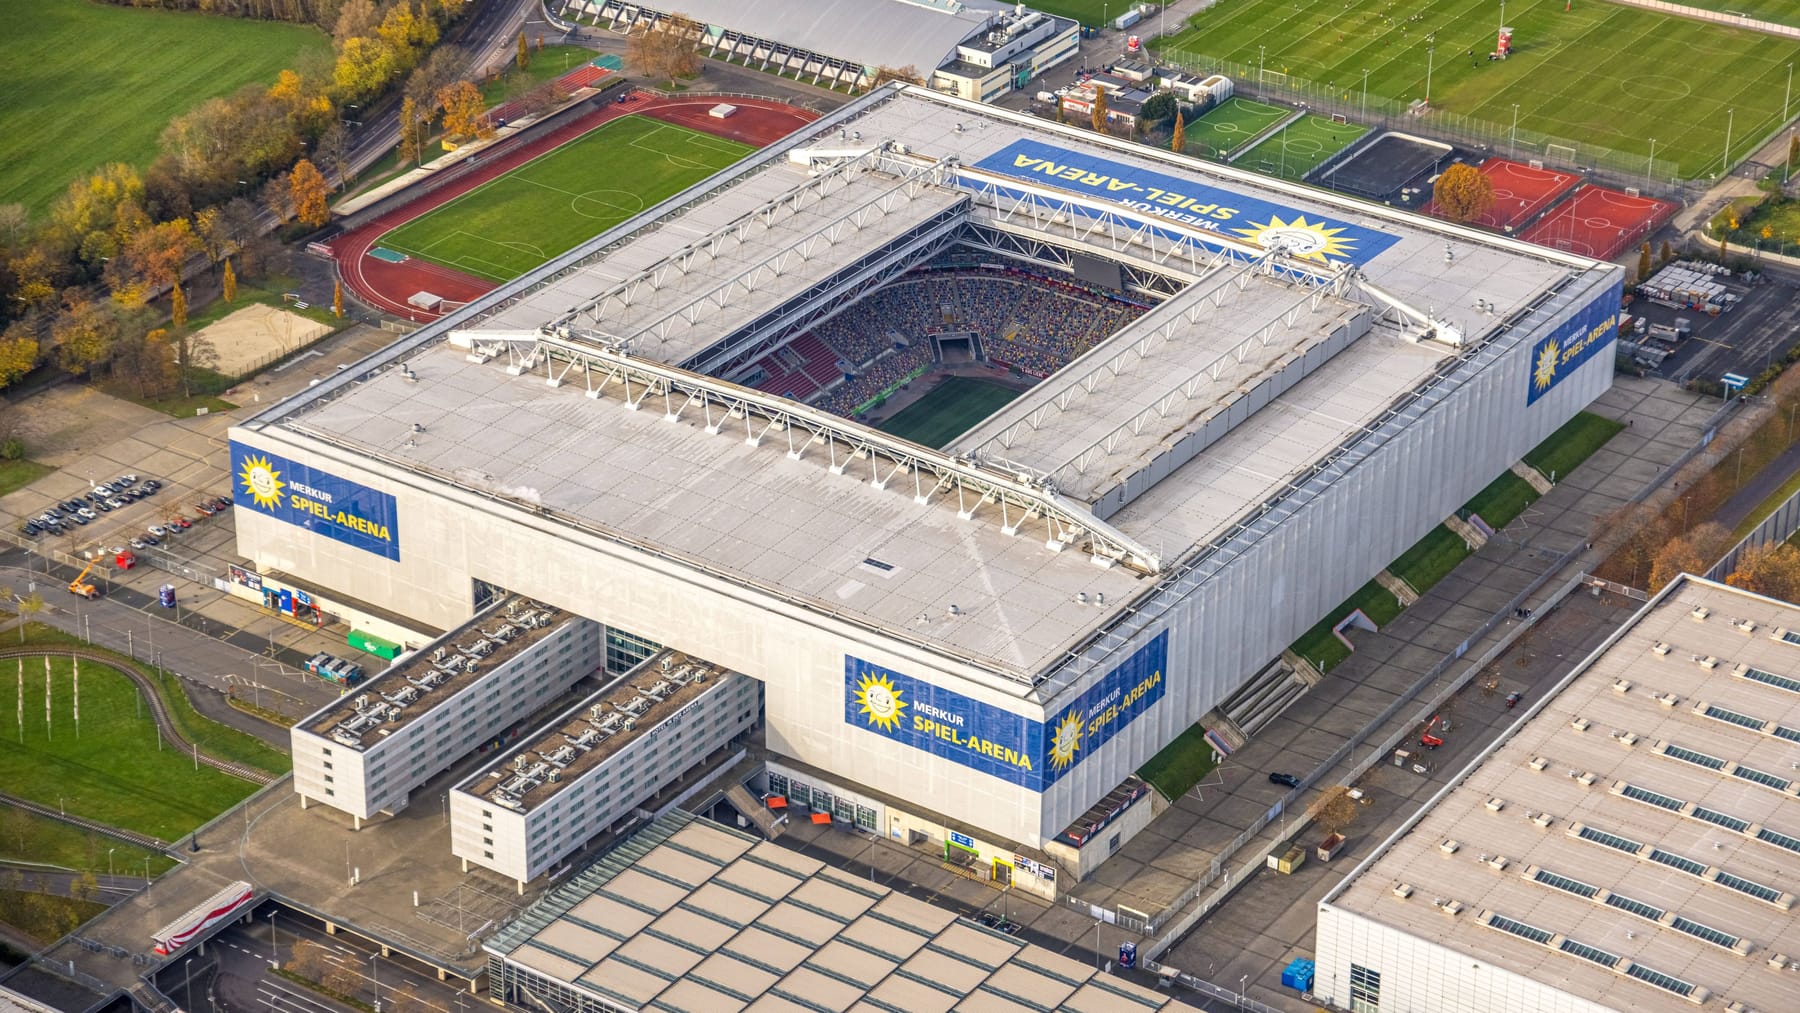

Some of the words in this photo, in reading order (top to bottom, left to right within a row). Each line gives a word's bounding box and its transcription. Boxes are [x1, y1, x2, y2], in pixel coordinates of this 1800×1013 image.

[1013, 153, 1240, 220] SPIEL-ARENA
[1118, 198, 1220, 230] MERKUR
[1561, 314, 1615, 366] SPIEL-ARENA
[289, 480, 333, 503] MERKUR
[290, 495, 391, 541] SPIEL-ARENA
[913, 700, 964, 726] MERKUR
[1088, 687, 1120, 719] MERKUR
[1088, 670, 1161, 738] SPIEL-ARENA
[912, 715, 1033, 771] SPIEL-ARENA
